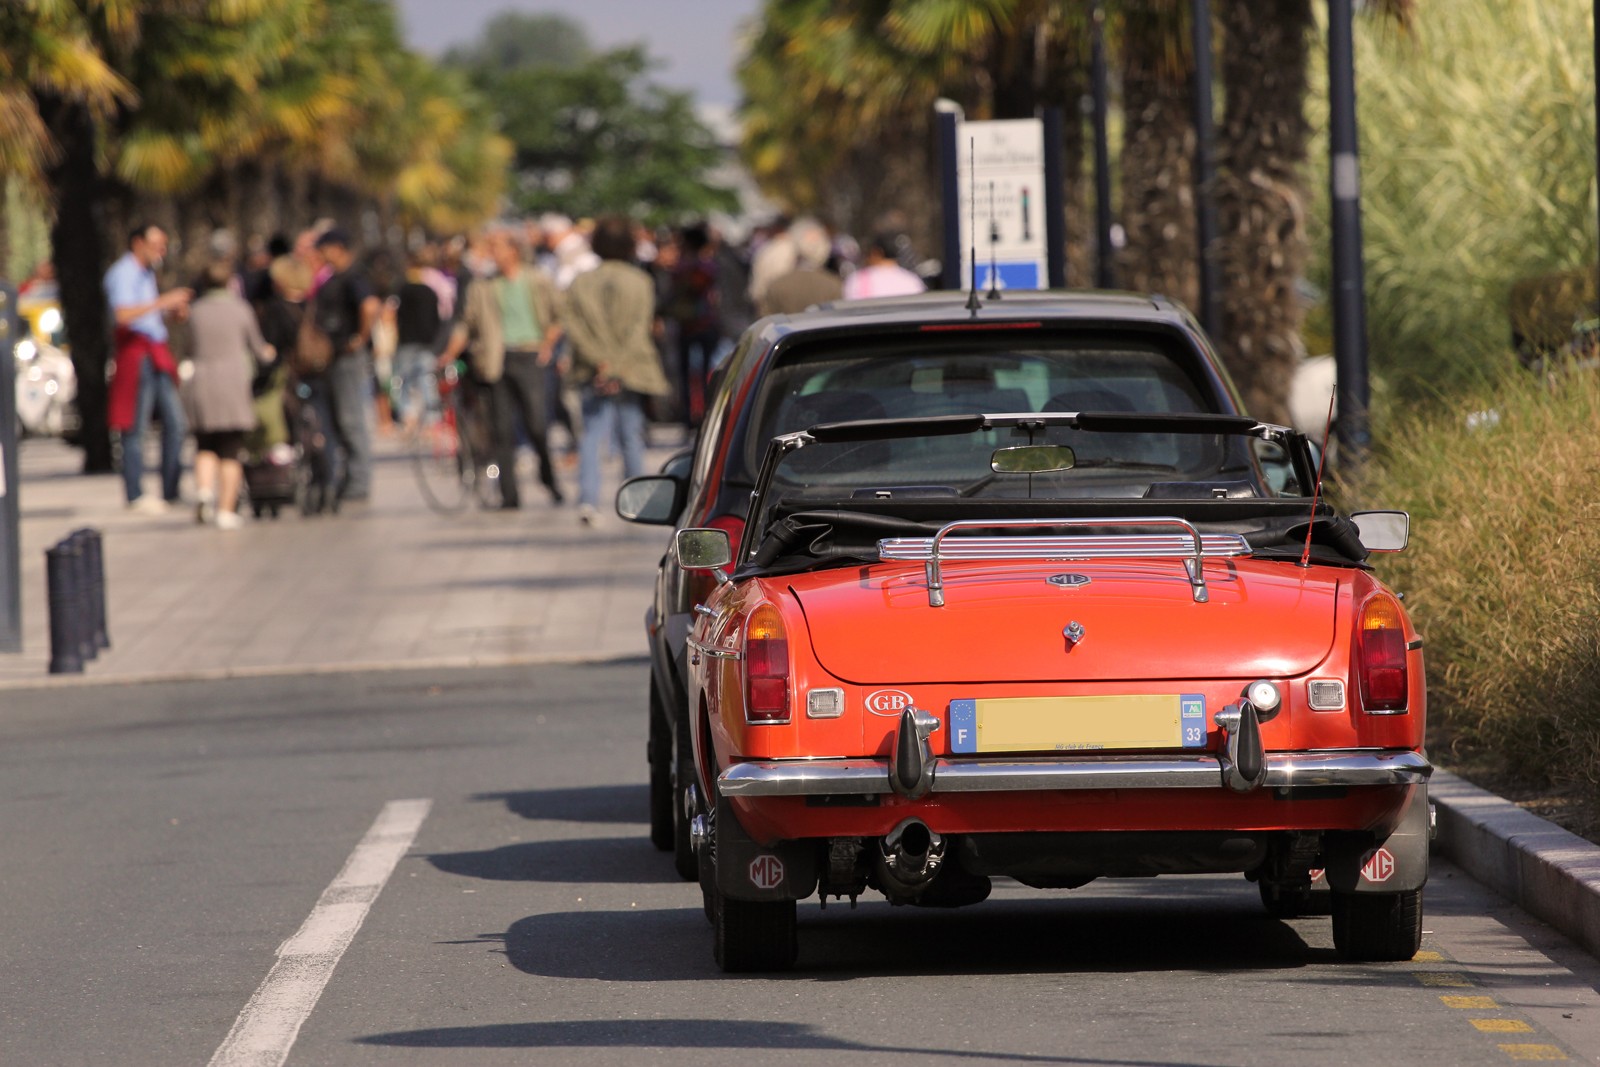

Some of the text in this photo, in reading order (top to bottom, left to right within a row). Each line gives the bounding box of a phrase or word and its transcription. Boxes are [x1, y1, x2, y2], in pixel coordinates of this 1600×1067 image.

[873, 695, 905, 711] GB
[958, 729, 968, 744] F
[1186, 727, 1201, 741] 33
[751, 856, 782, 887] MG
[1361, 849, 1393, 880] MG
